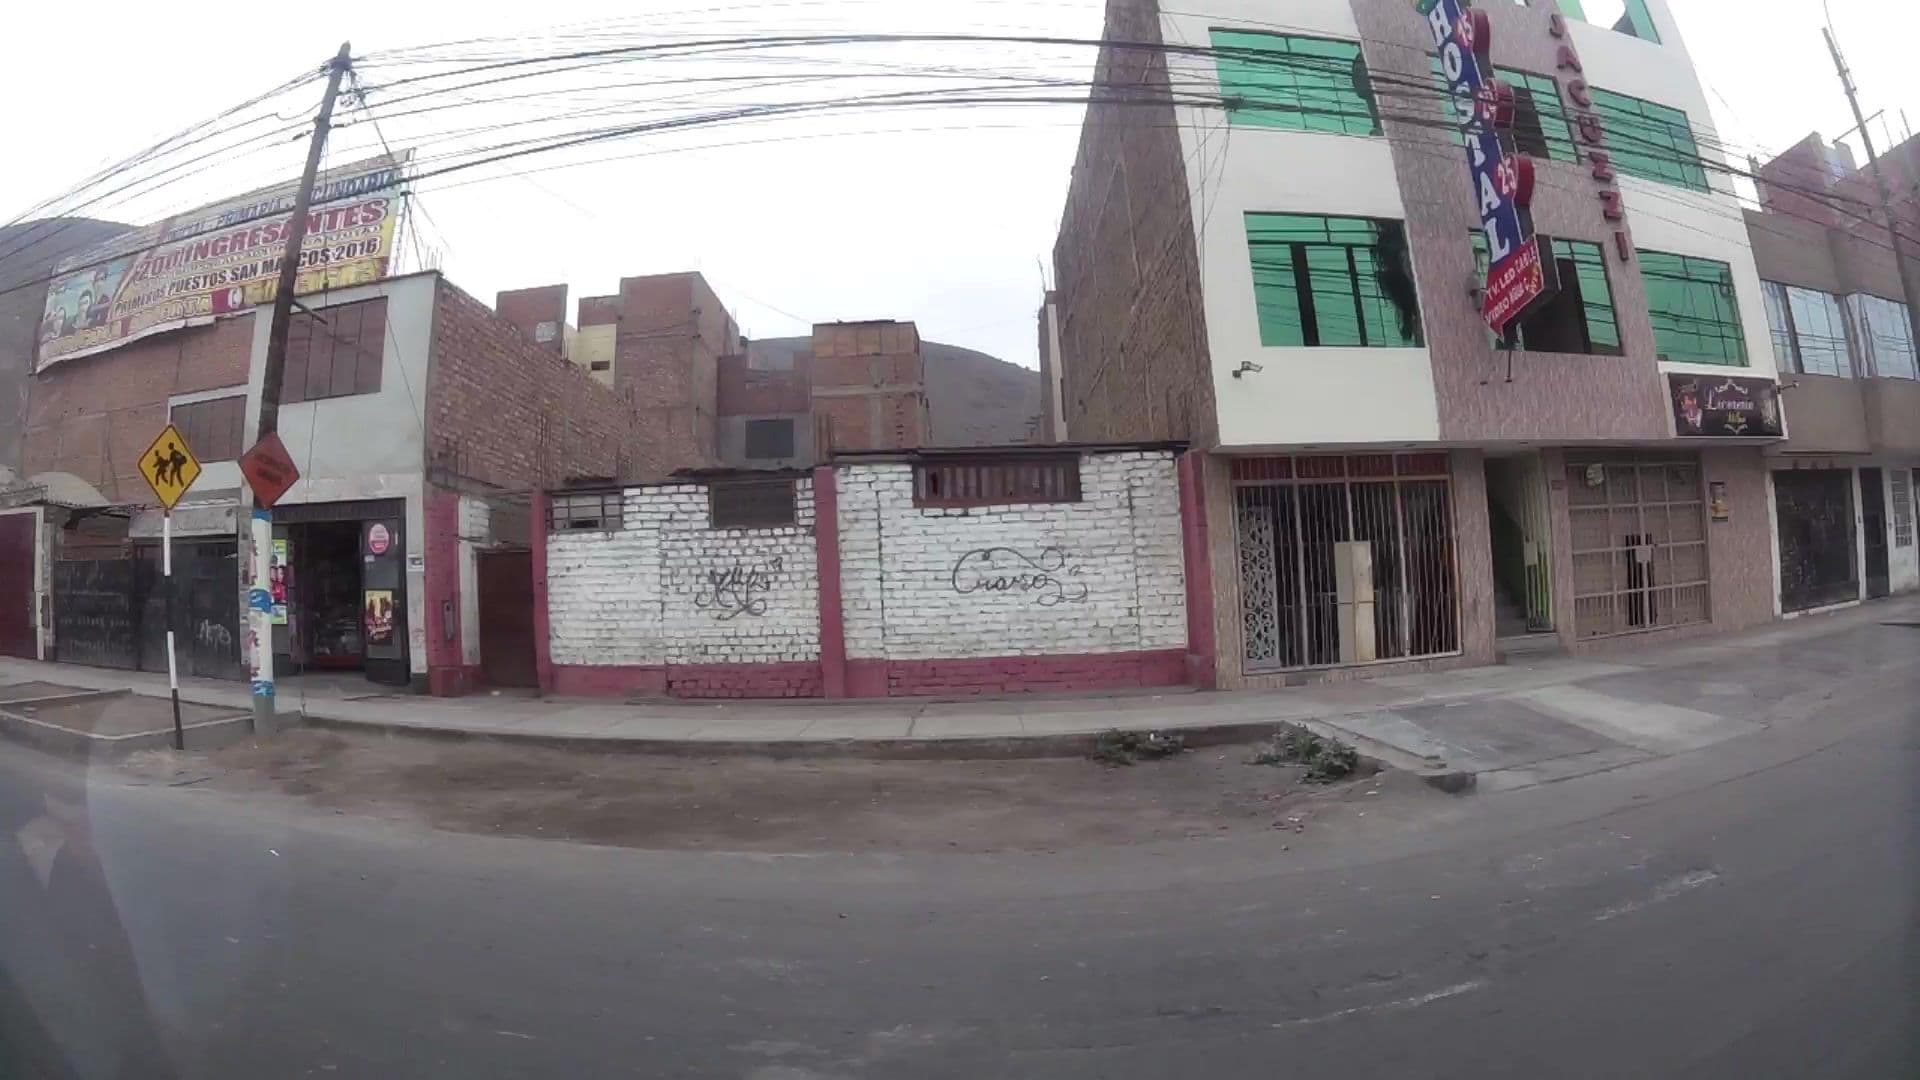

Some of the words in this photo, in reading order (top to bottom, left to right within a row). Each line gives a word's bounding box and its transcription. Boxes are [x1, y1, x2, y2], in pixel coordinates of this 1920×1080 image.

[1429, 0, 1509, 263] HOSTAL
[1549, 13, 1630, 261] JACUZZI
[168, 270, 227, 294] PUESTOS
[230, 262, 258, 281] SAN
[261, 247, 330, 275] MACOS
[335, 238, 379, 261] 2016
